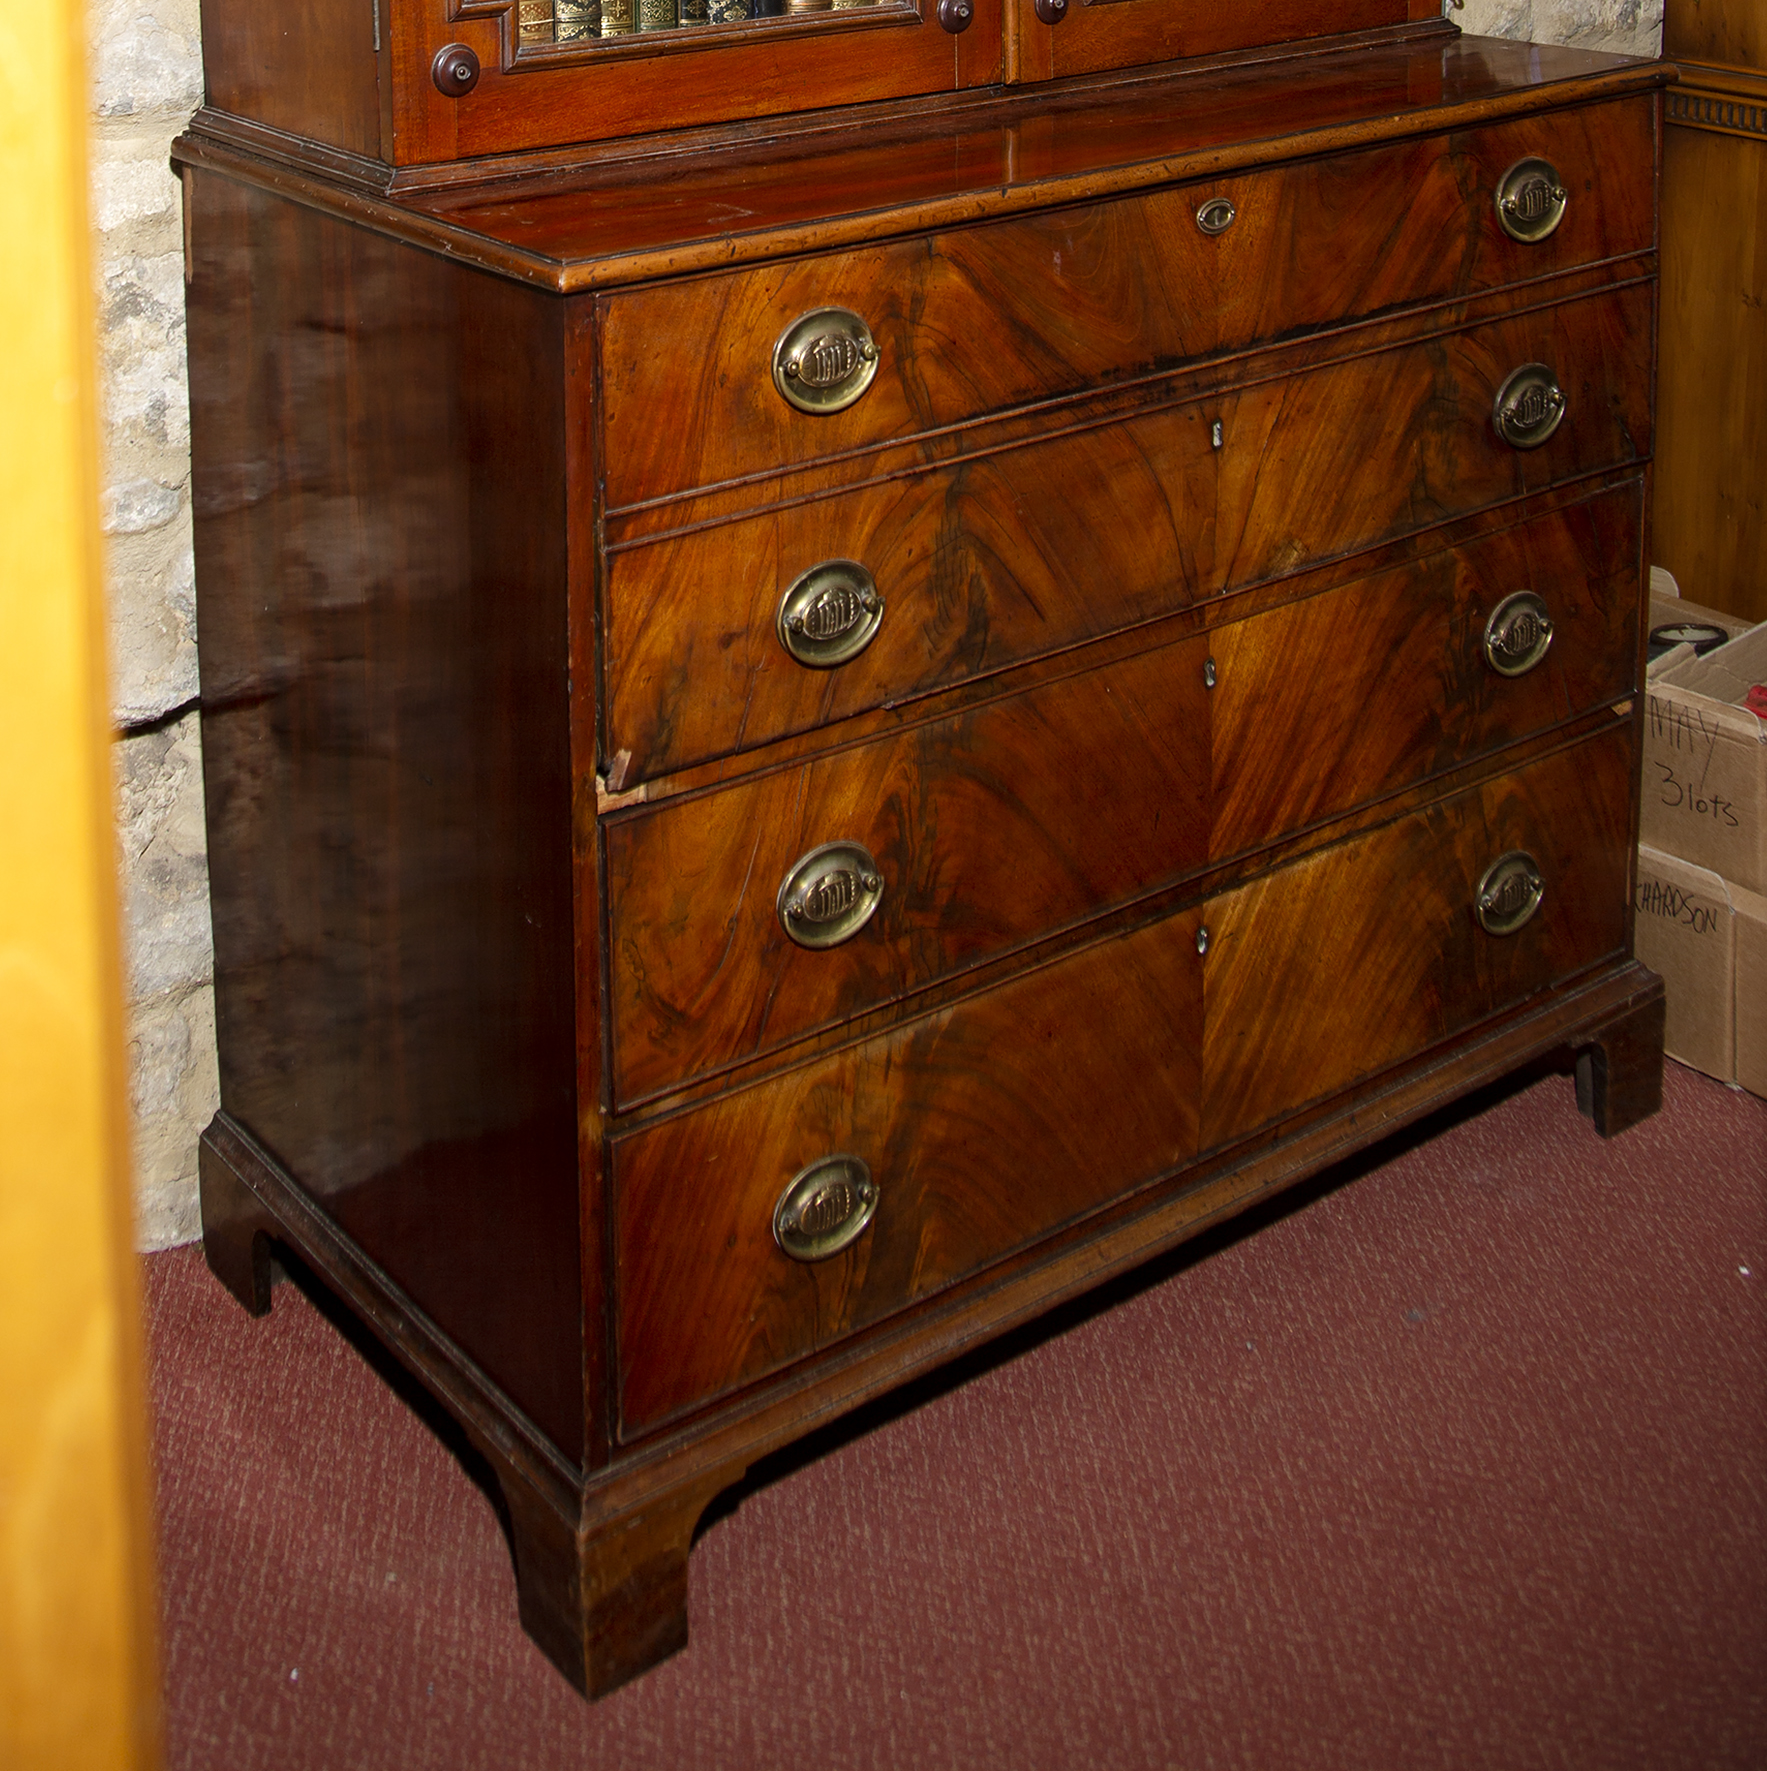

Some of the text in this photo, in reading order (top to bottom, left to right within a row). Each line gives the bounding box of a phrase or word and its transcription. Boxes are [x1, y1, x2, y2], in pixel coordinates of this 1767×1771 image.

[1651, 695, 1719, 792] MAY
[1654, 761, 1739, 827] 3 lots
